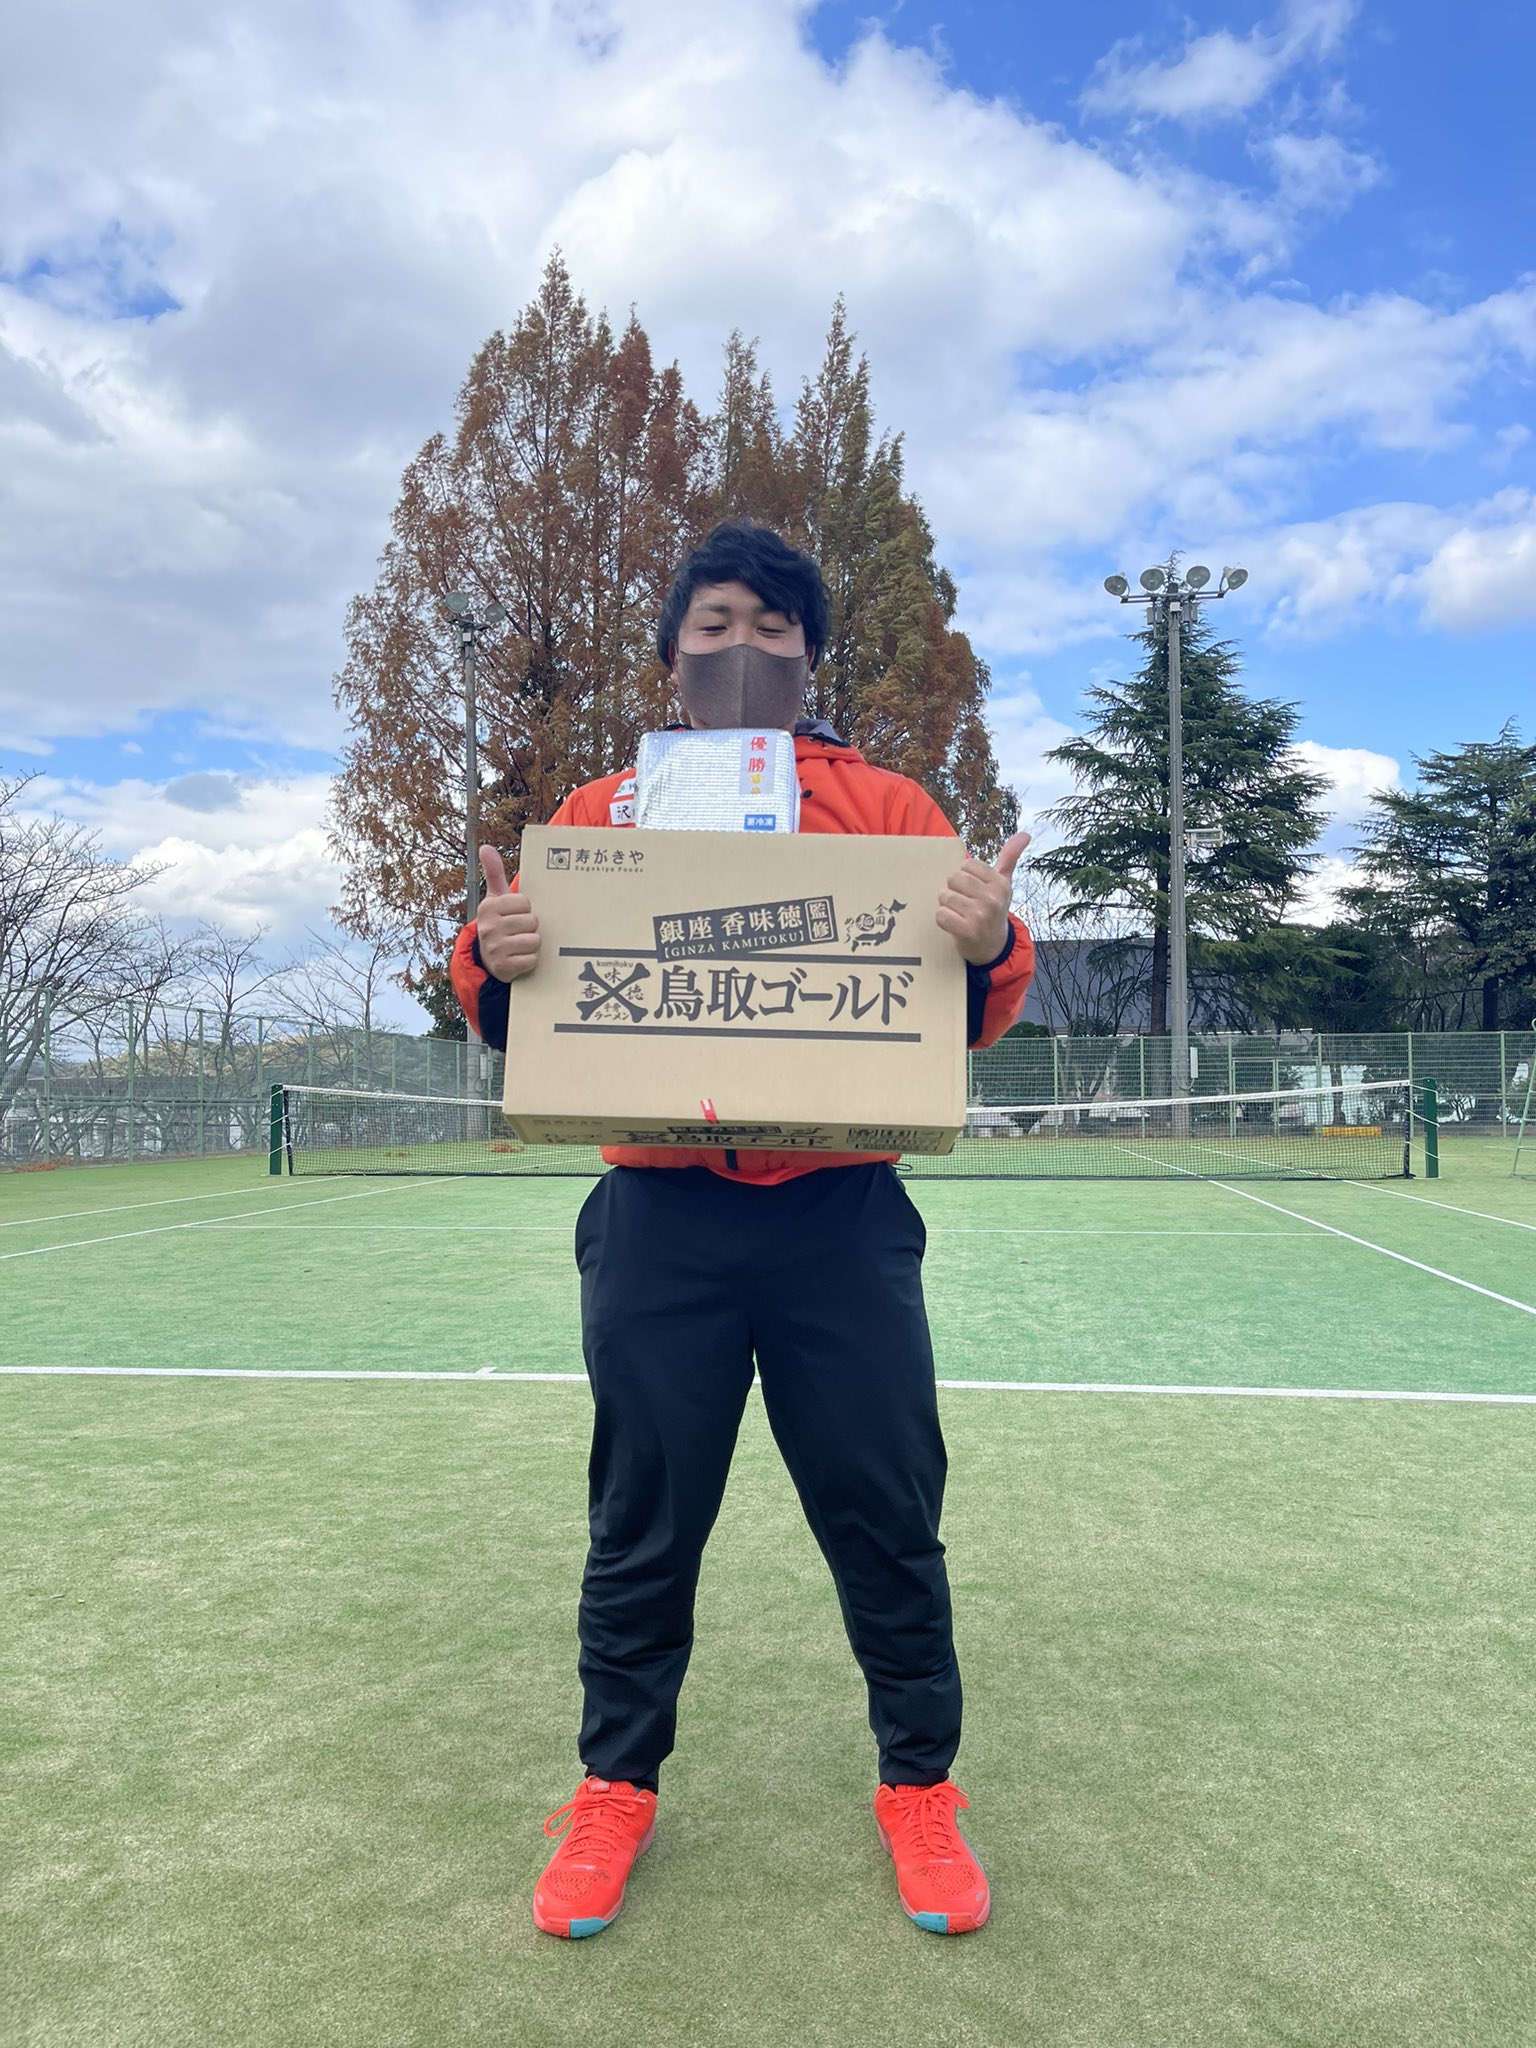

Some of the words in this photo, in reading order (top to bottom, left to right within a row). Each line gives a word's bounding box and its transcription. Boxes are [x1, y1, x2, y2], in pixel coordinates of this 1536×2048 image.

[748, 736, 768, 773] 優勝
[575, 848, 645, 865] 寿がきや
[659, 916, 714, 945] 銀座
[720, 905, 803, 937] 香味徳
[808, 902, 830, 939] 監修
[596, 960, 634, 968] kamitoku
[604, 967, 622, 984] 味
[653, 965, 915, 1026] 鳥取ゴールド
[594, 1011, 630, 1021] ラーメン
